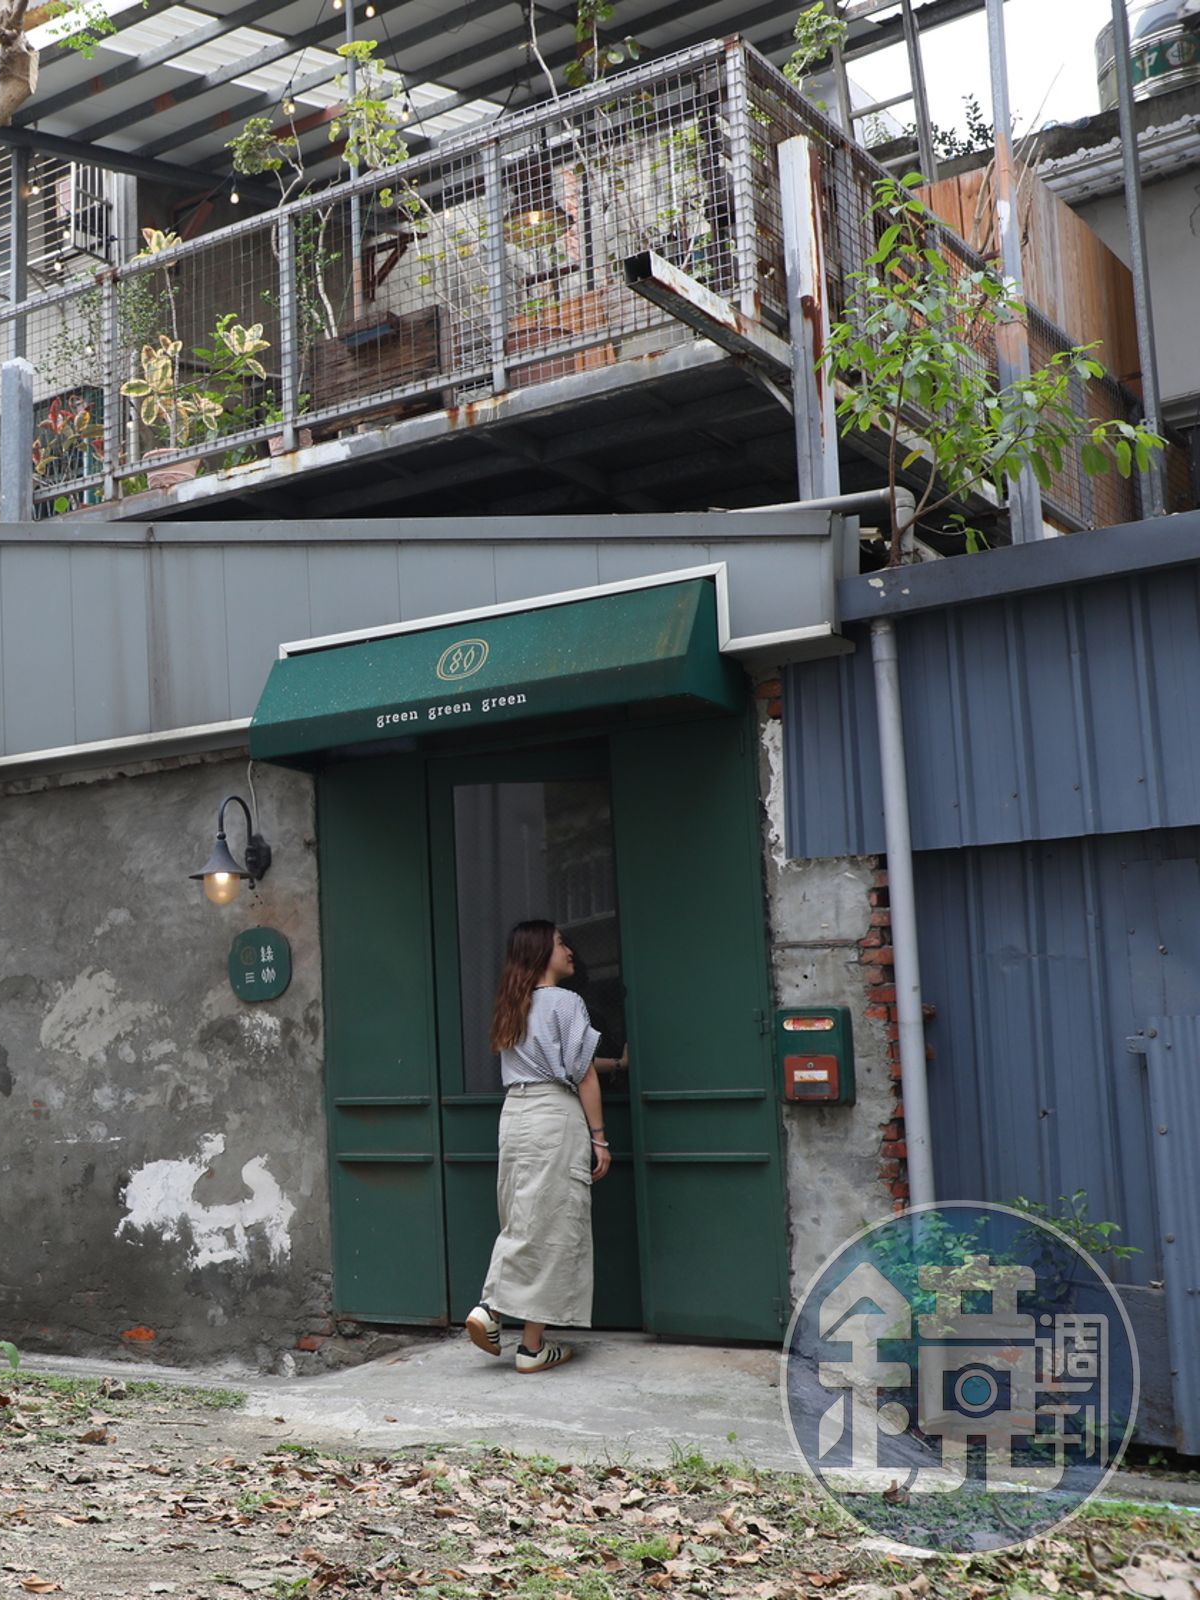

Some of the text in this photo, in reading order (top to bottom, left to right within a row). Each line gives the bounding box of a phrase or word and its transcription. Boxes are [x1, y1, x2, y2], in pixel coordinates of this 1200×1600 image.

[376, 693, 527, 728] green green green
